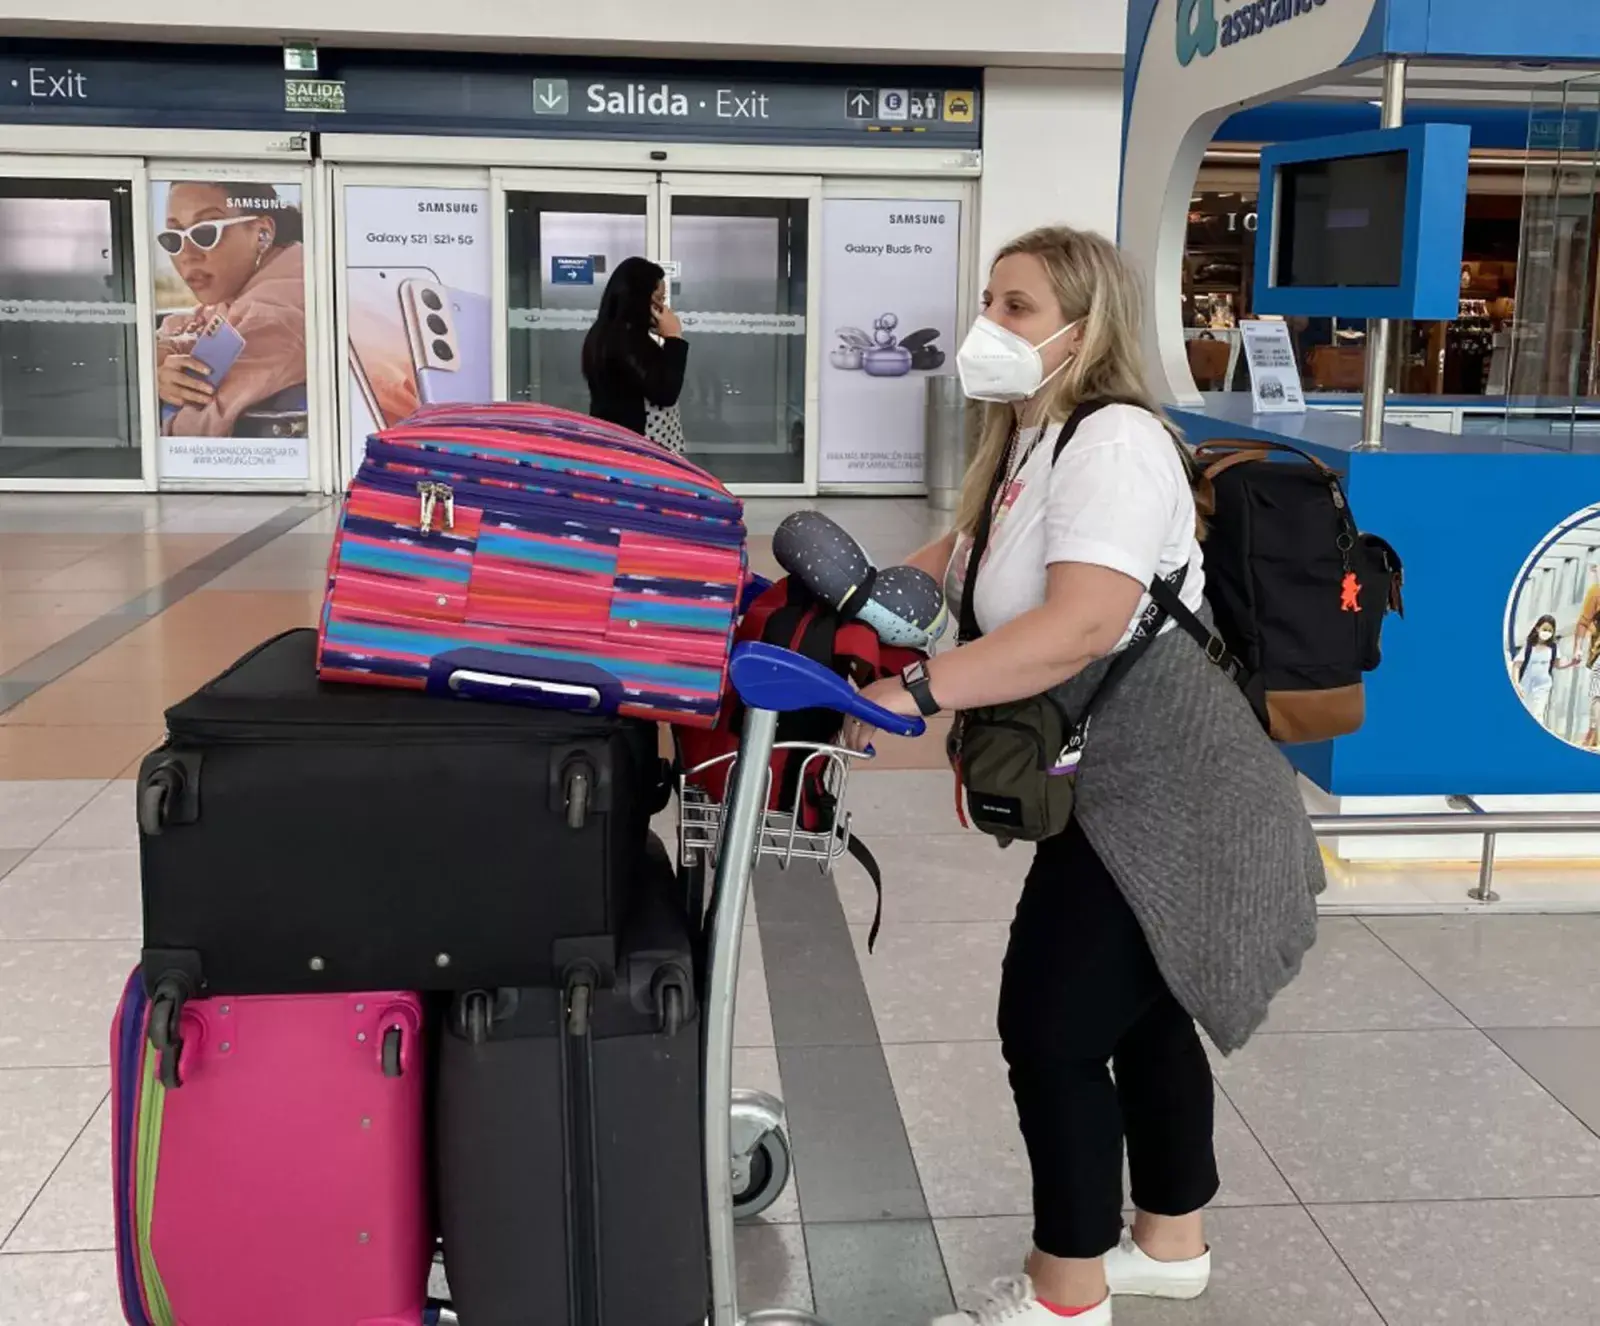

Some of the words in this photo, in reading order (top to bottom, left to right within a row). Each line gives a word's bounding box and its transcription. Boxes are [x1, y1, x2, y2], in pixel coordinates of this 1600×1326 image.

[29, 67, 88, 98] Exit
[286, 83, 344, 97] SALIDA
[587, 83, 689, 116] Salida
[716, 89, 769, 118] Exit
[226, 197, 287, 209] SAMSUNG
[417, 202, 478, 213] SAMSUNG
[888, 213, 946, 224] SAMSUNG
[366, 232, 408, 245] Galaxy
[410, 234, 428, 244] S21
[458, 234, 474, 245] 5G
[844, 243, 884, 256] Galaxy
[886, 243, 913, 255] Buds
[914, 243, 932, 254] Pro
